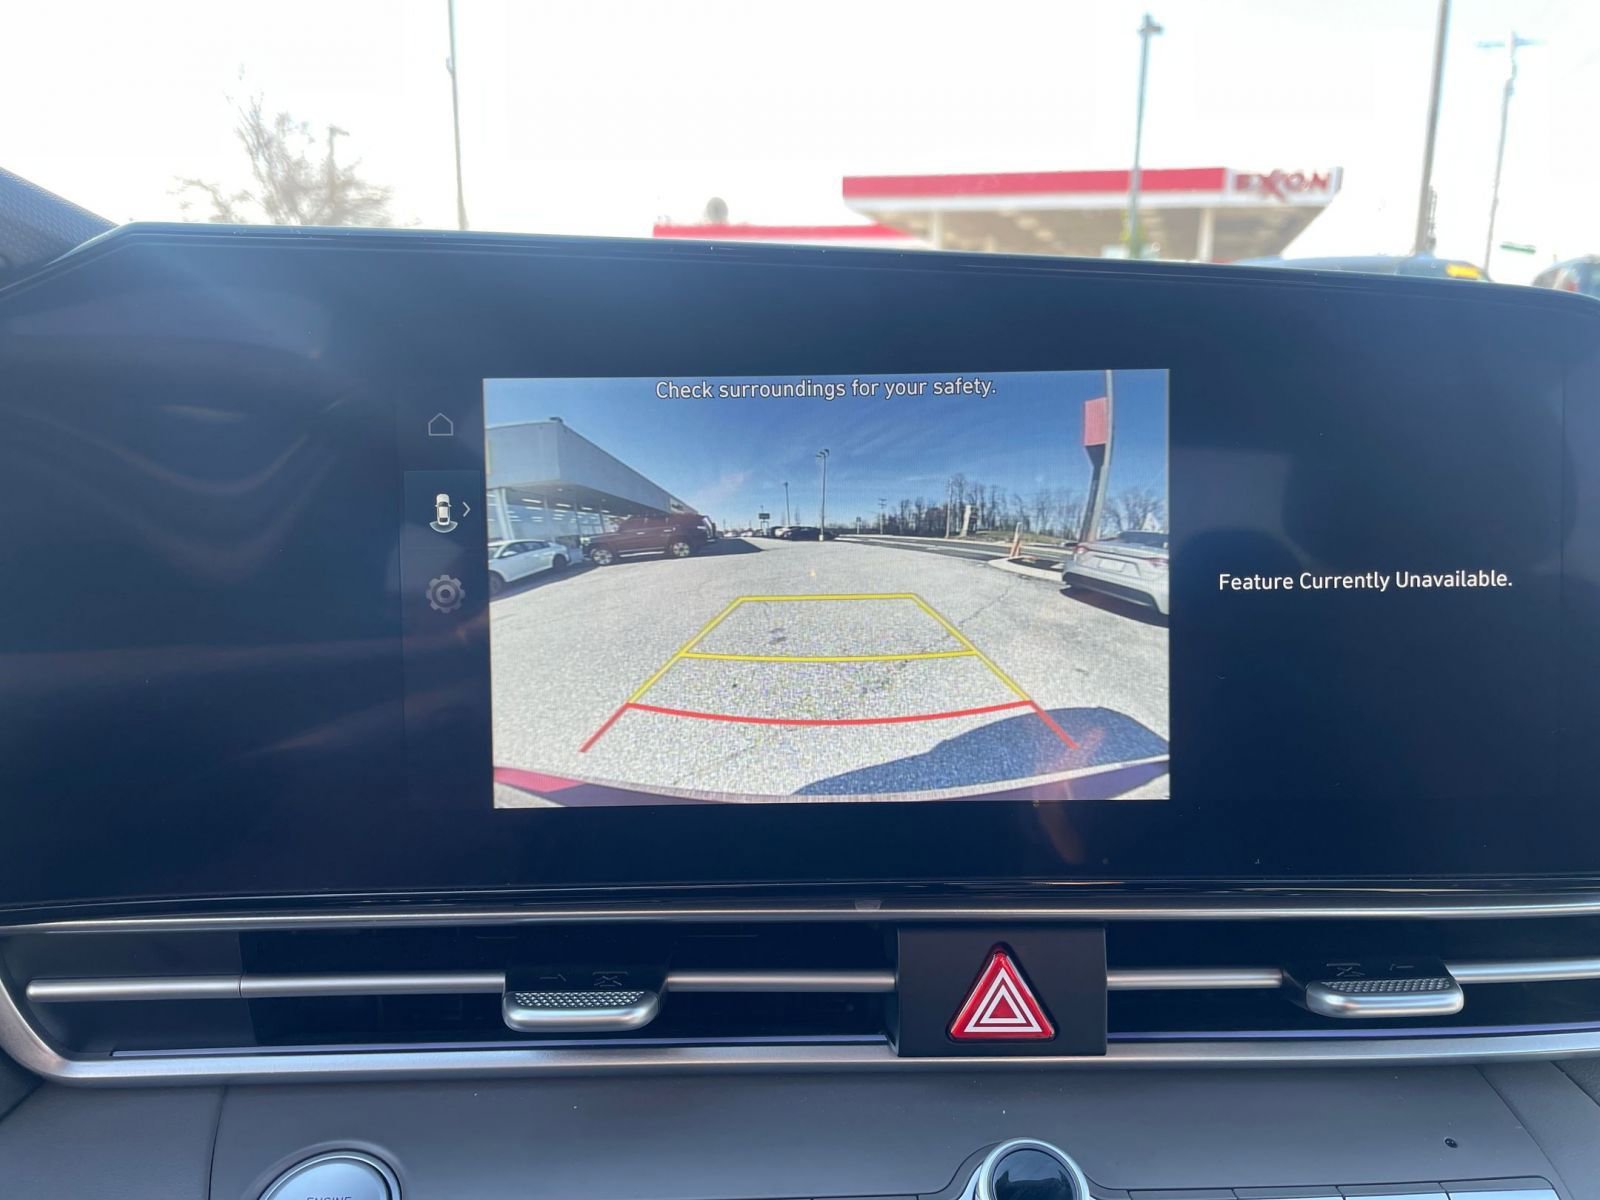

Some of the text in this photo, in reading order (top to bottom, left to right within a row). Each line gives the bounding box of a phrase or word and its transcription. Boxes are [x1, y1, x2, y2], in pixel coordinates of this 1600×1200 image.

[656, 377, 997, 400] Check surroundings for your safety.
[1218, 570, 1513, 592] Feature Currently Unavailable.
